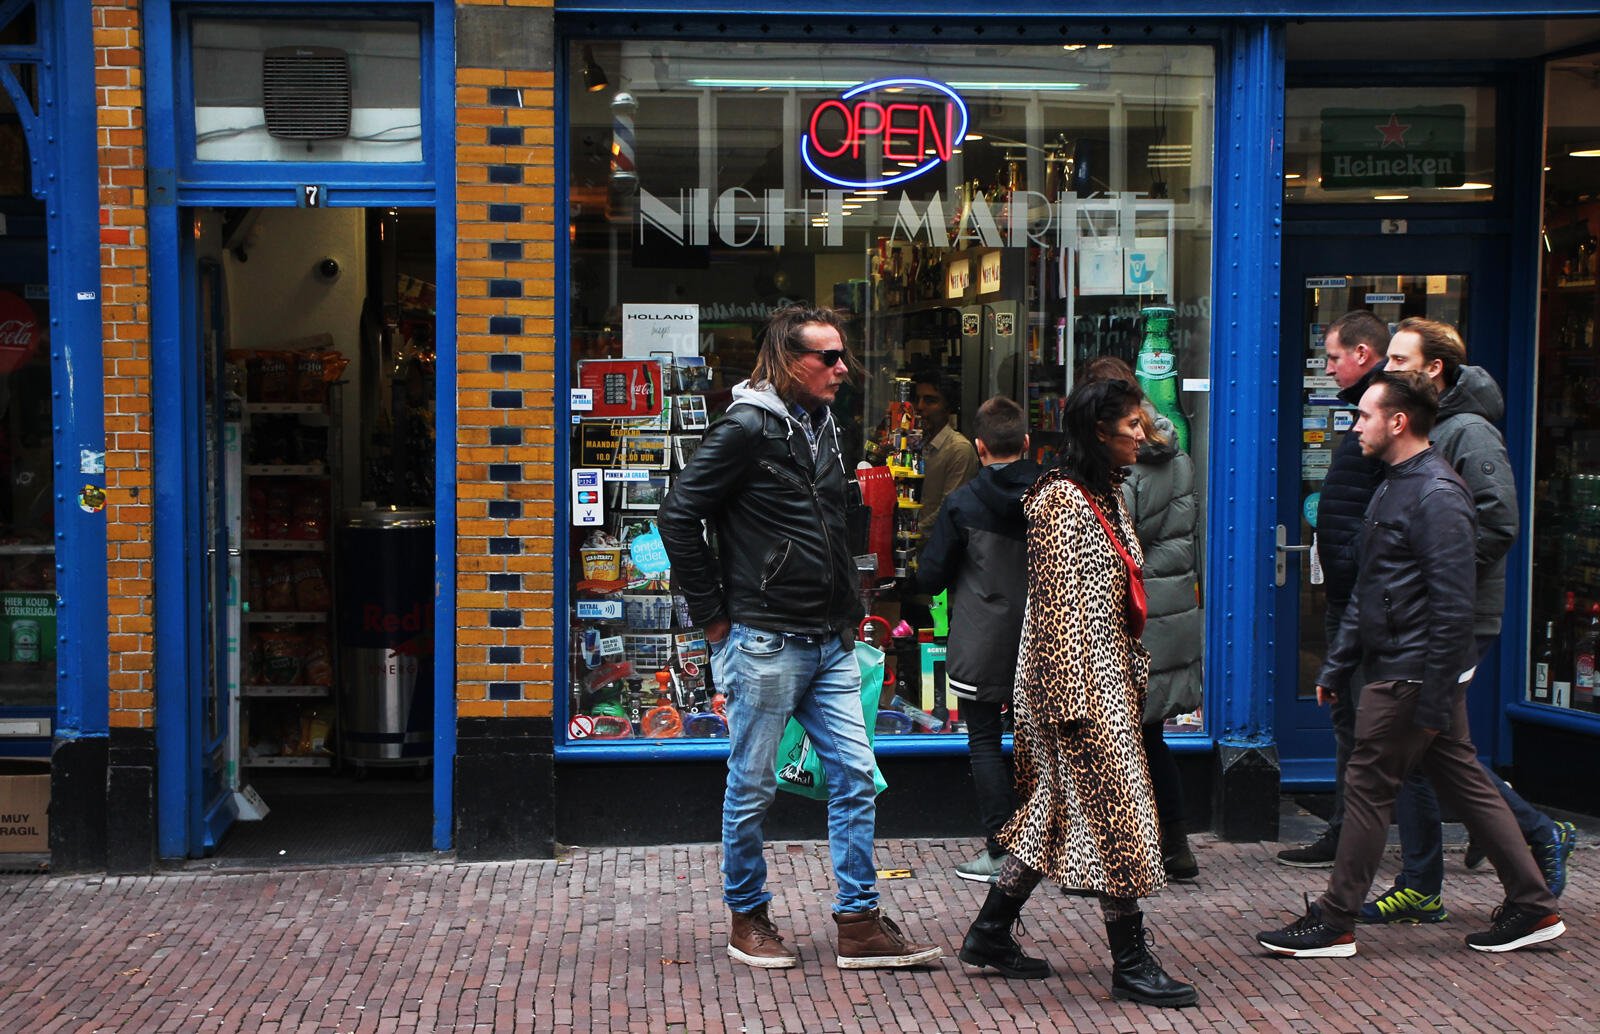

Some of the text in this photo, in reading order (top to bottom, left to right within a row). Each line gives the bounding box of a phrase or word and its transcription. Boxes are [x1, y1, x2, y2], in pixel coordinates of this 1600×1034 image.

[810, 100, 952, 162] OPEN
[1333, 154, 1453, 177] Heineken
[305, 185, 317, 207] 7
[640, 186, 1149, 248] NIGHT MARKT
[1388, 219, 1399, 233] 5
[627, 313, 694, 321] HOLLAND
[635, 550, 662, 563] cider
[4, 596, 49, 607] HIER KOUD
[4, 606, 56, 616] VERKRIJGBA
[780, 765, 811, 785] Normal
[2, 814, 30, 824] MUY
[0, 826, 39, 836] RAGIL
